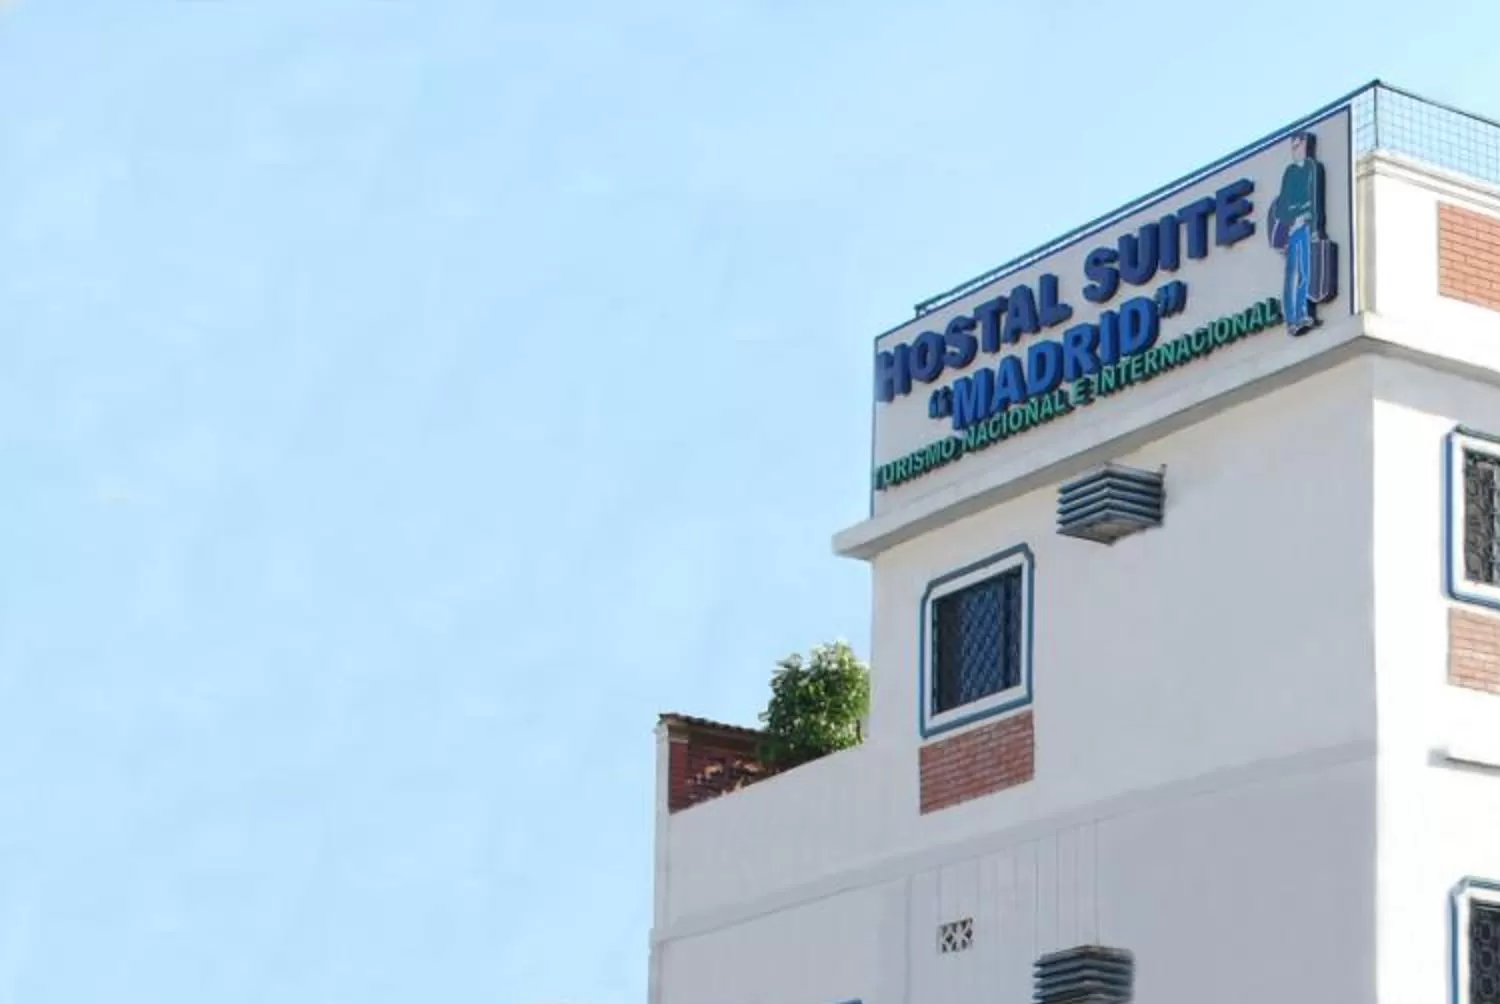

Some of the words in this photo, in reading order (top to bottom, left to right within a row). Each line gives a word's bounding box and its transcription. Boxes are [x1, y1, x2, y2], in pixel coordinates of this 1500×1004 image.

[874, 273, 1073, 402] HOSTAL
[1082, 178, 1256, 304] SUITE
[874, 436, 962, 491] TURISMO
[959, 389, 1075, 455] NACIONAL
[1095, 297, 1284, 398] INTERNACIONAL
